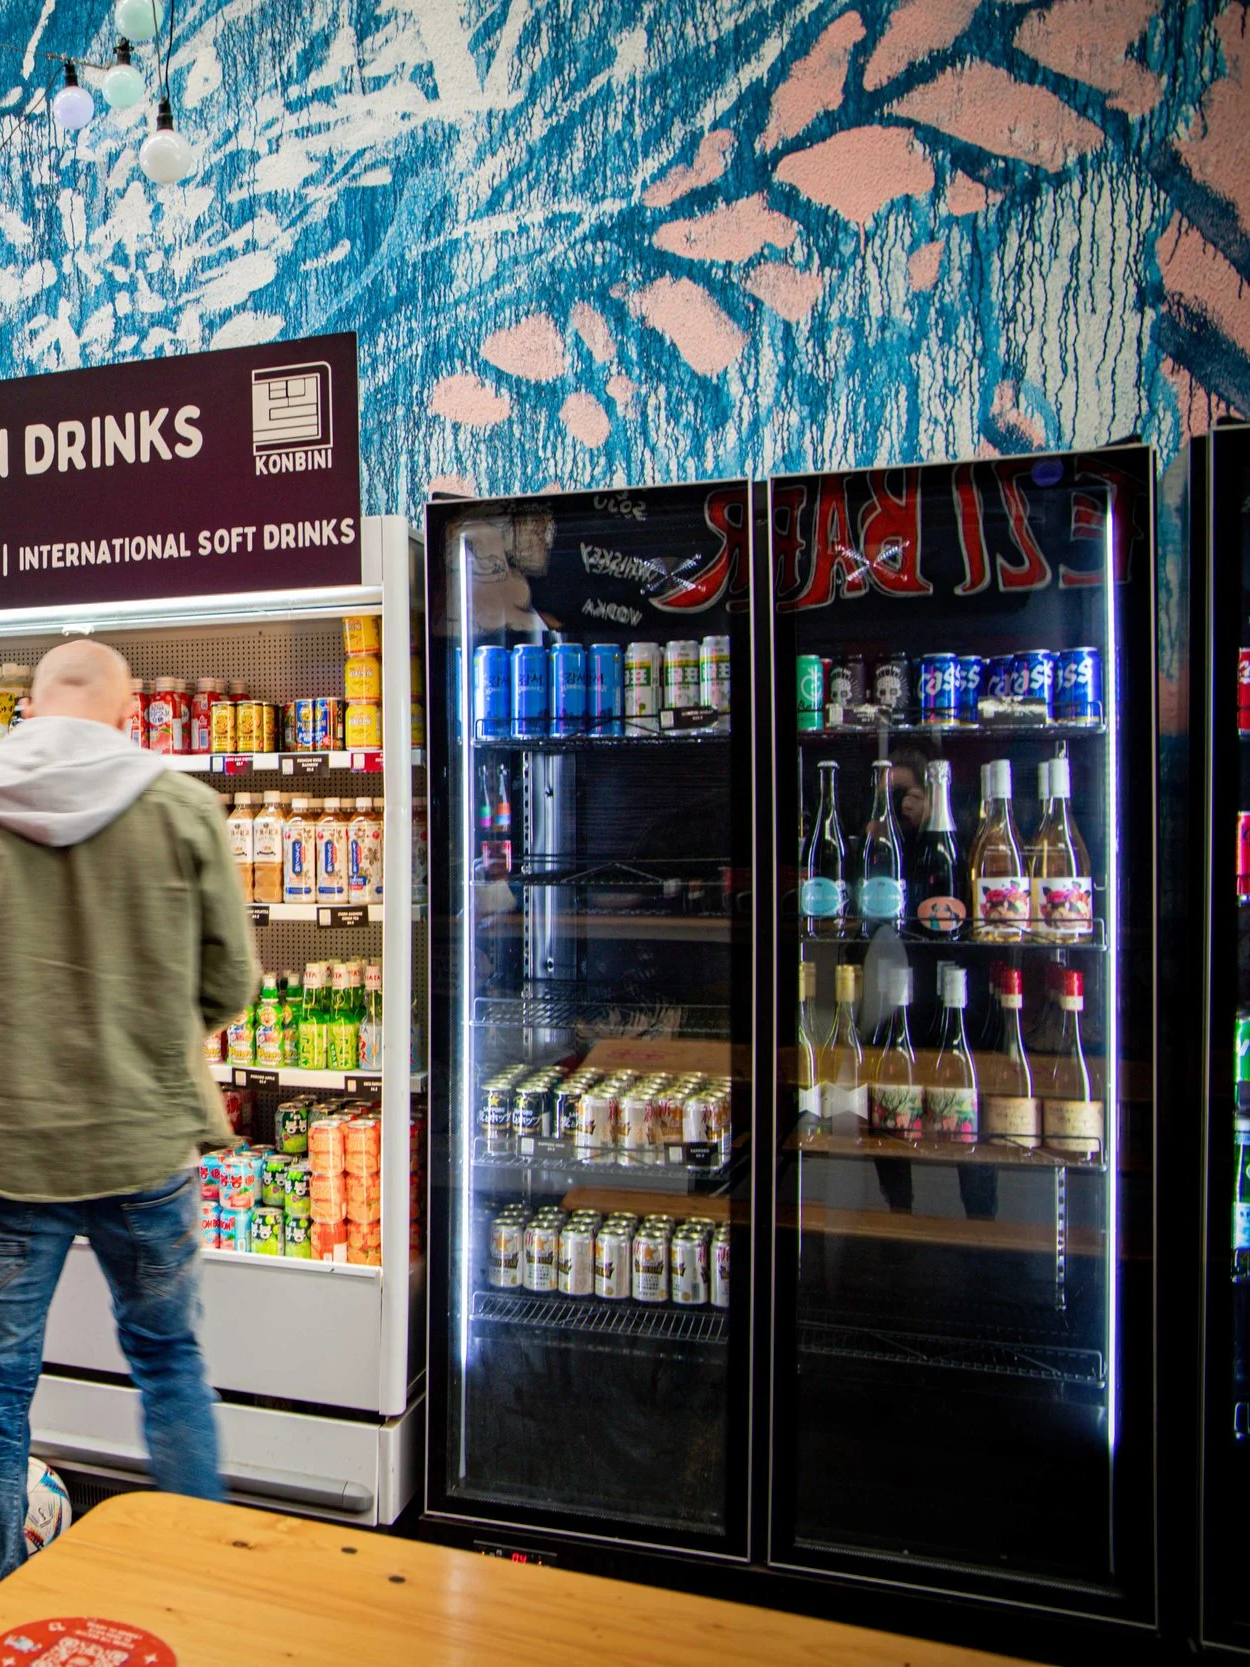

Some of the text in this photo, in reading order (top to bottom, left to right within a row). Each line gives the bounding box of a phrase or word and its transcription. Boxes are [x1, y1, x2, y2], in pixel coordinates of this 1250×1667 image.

[25, 404, 204, 476] DRINKS
[255, 449, 333, 476] KONBINI
[19, 533, 192, 571] INTERNATIONAL
[197, 526, 256, 557] SOFT
[263, 517, 356, 551] DRINKS
